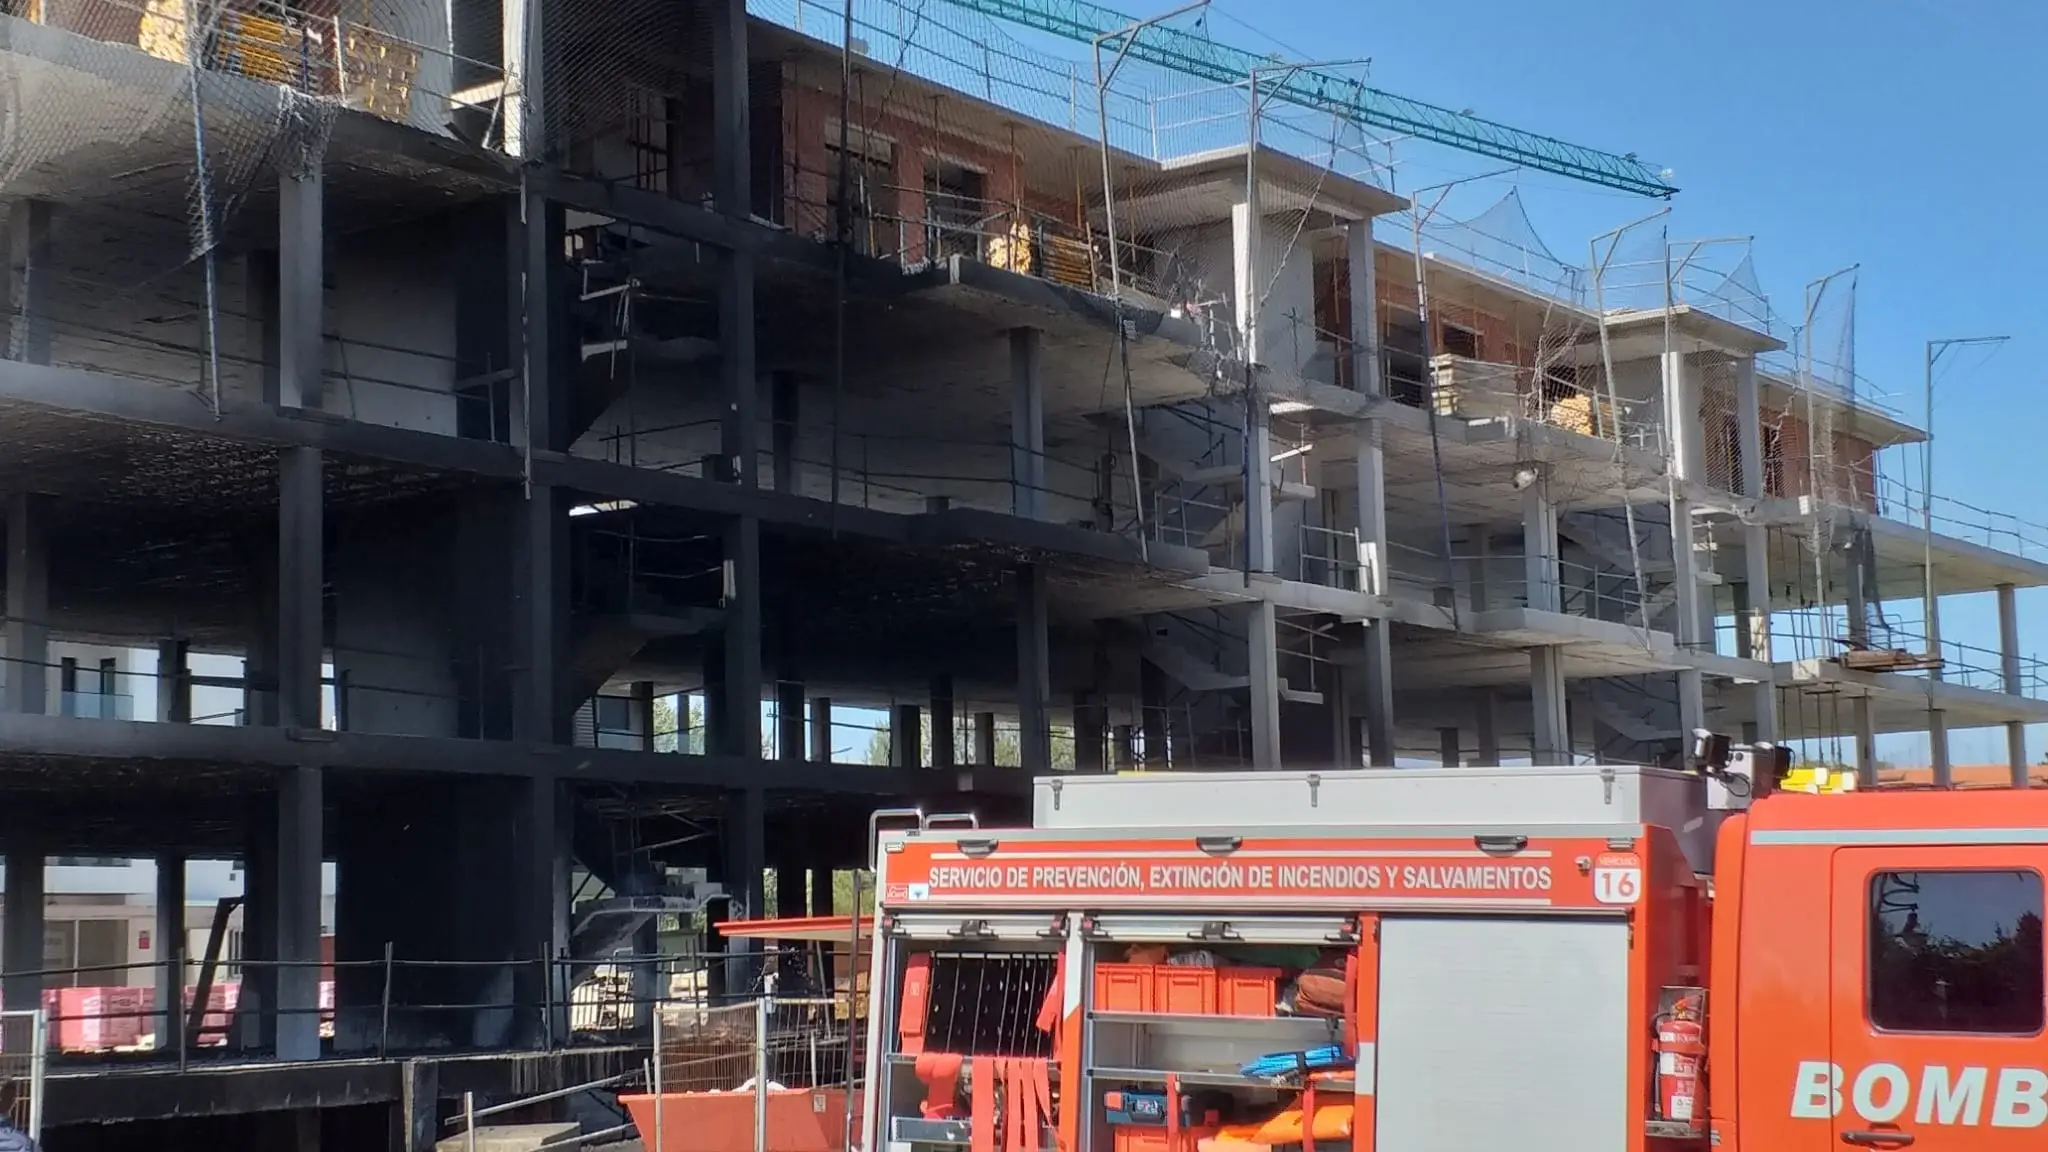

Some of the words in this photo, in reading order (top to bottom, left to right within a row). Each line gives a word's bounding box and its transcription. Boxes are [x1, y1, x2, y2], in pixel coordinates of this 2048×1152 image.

[929, 866, 1002, 888] SERVICIO
[1006, 866, 1029, 888] DE
[1033, 861, 1145, 892] PREVENCIÓN,
[1150, 861, 1244, 888] EXTINCIÓN
[1248, 866, 1273, 888] DE
[1278, 865, 1381, 888] INCENDIOS
[1385, 865, 1399, 888] Y
[1403, 865, 1552, 889] SALVAMENTOS
[1602, 872, 1635, 898] 16
[1790, 1060, 2048, 1128] BOMB
